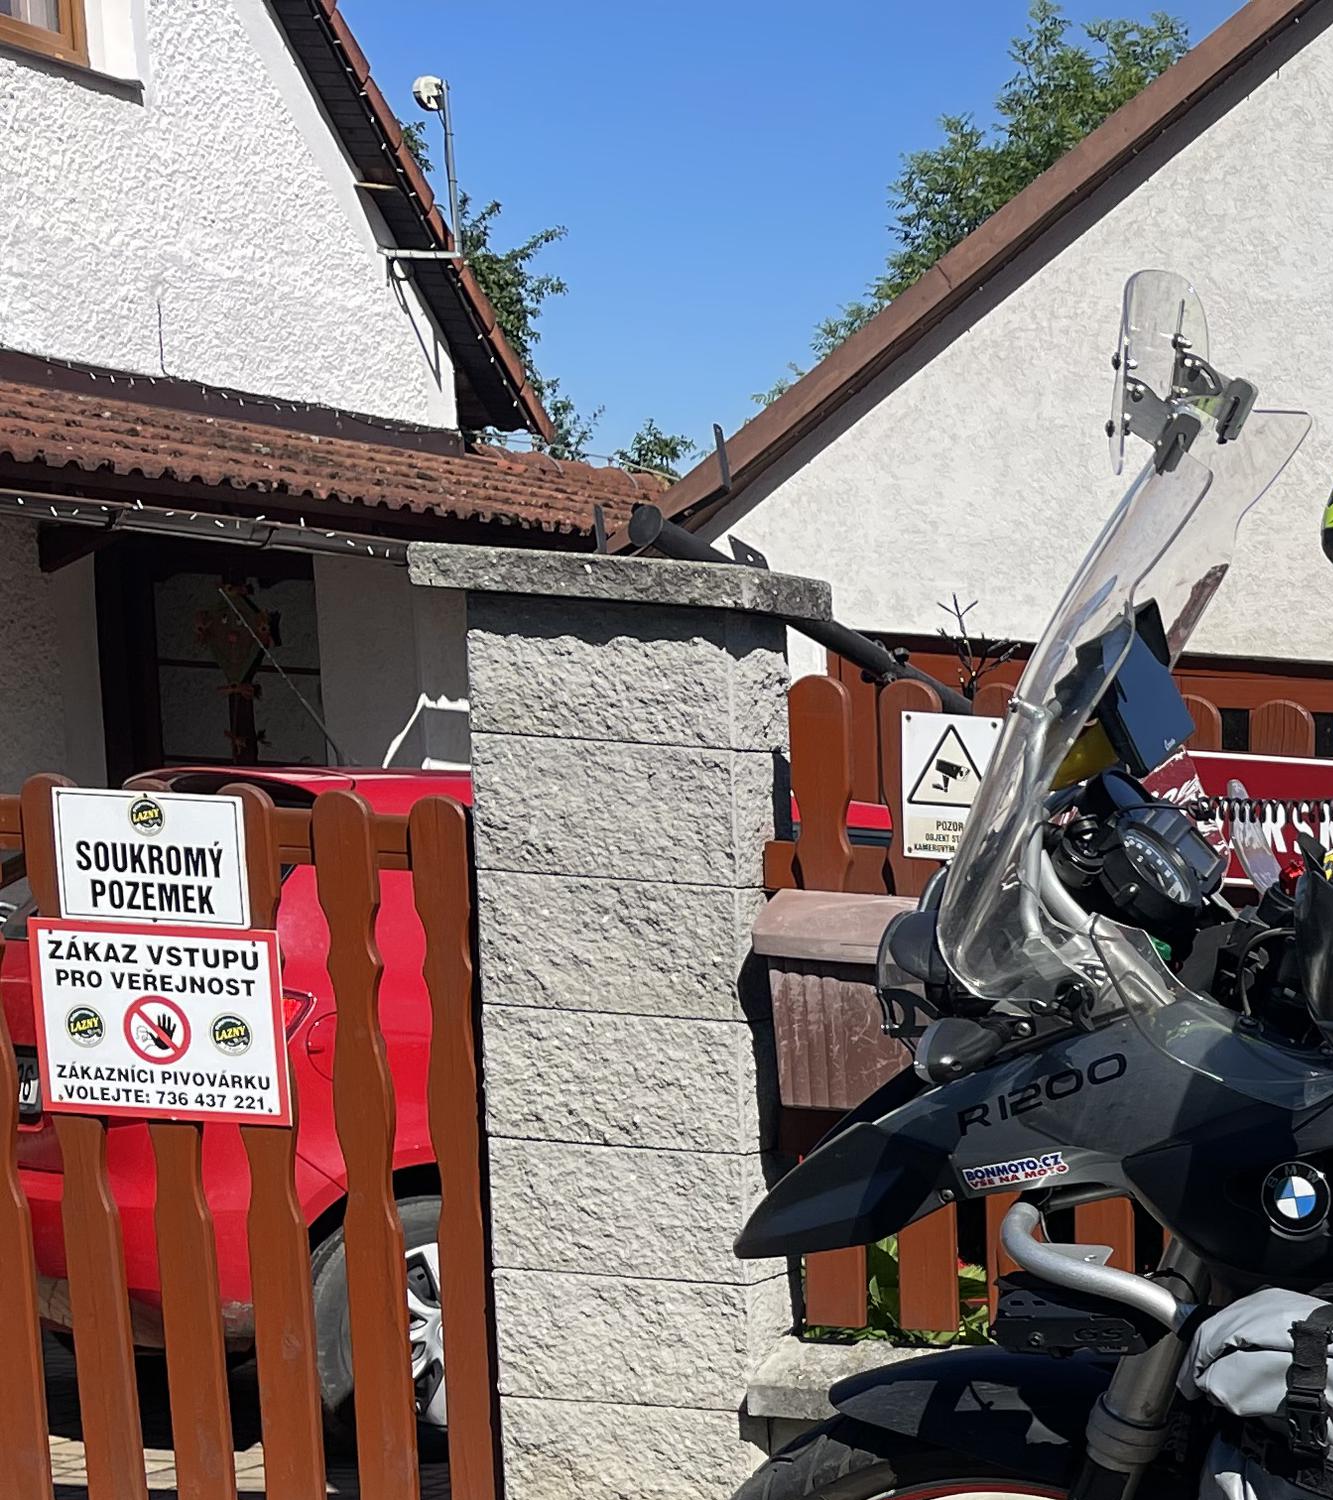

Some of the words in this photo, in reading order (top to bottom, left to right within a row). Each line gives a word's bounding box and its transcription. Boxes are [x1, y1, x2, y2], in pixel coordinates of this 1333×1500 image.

[935, 820, 964, 831] POZOR
[76, 840, 224, 879] SOUKROMÝ
[90, 879, 216, 915] POZEMEK
[48, 935, 139, 965] ZÁKAZ
[147, 944, 260, 971] VSTUPU
[55, 968, 104, 989] PRO
[110, 968, 256, 997] VEŘEJNOST
[56, 1062, 155, 1084] ZÁKAZNÍCI
[161, 1068, 271, 1091] PIVOVÁRKU
[63, 1084, 151, 1104] VOLEJTE:
[156, 1090, 190, 1107] 736
[194, 1092, 228, 1109] 437
[234, 1094, 265, 1110] 221
[965, 1154, 1062, 1181] BONMOTO.CZ
[1000, 1174, 1021, 1183] NA
[1024, 1164, 1068, 1179] MOTO
[1266, 1164, 1320, 1189] BMW
